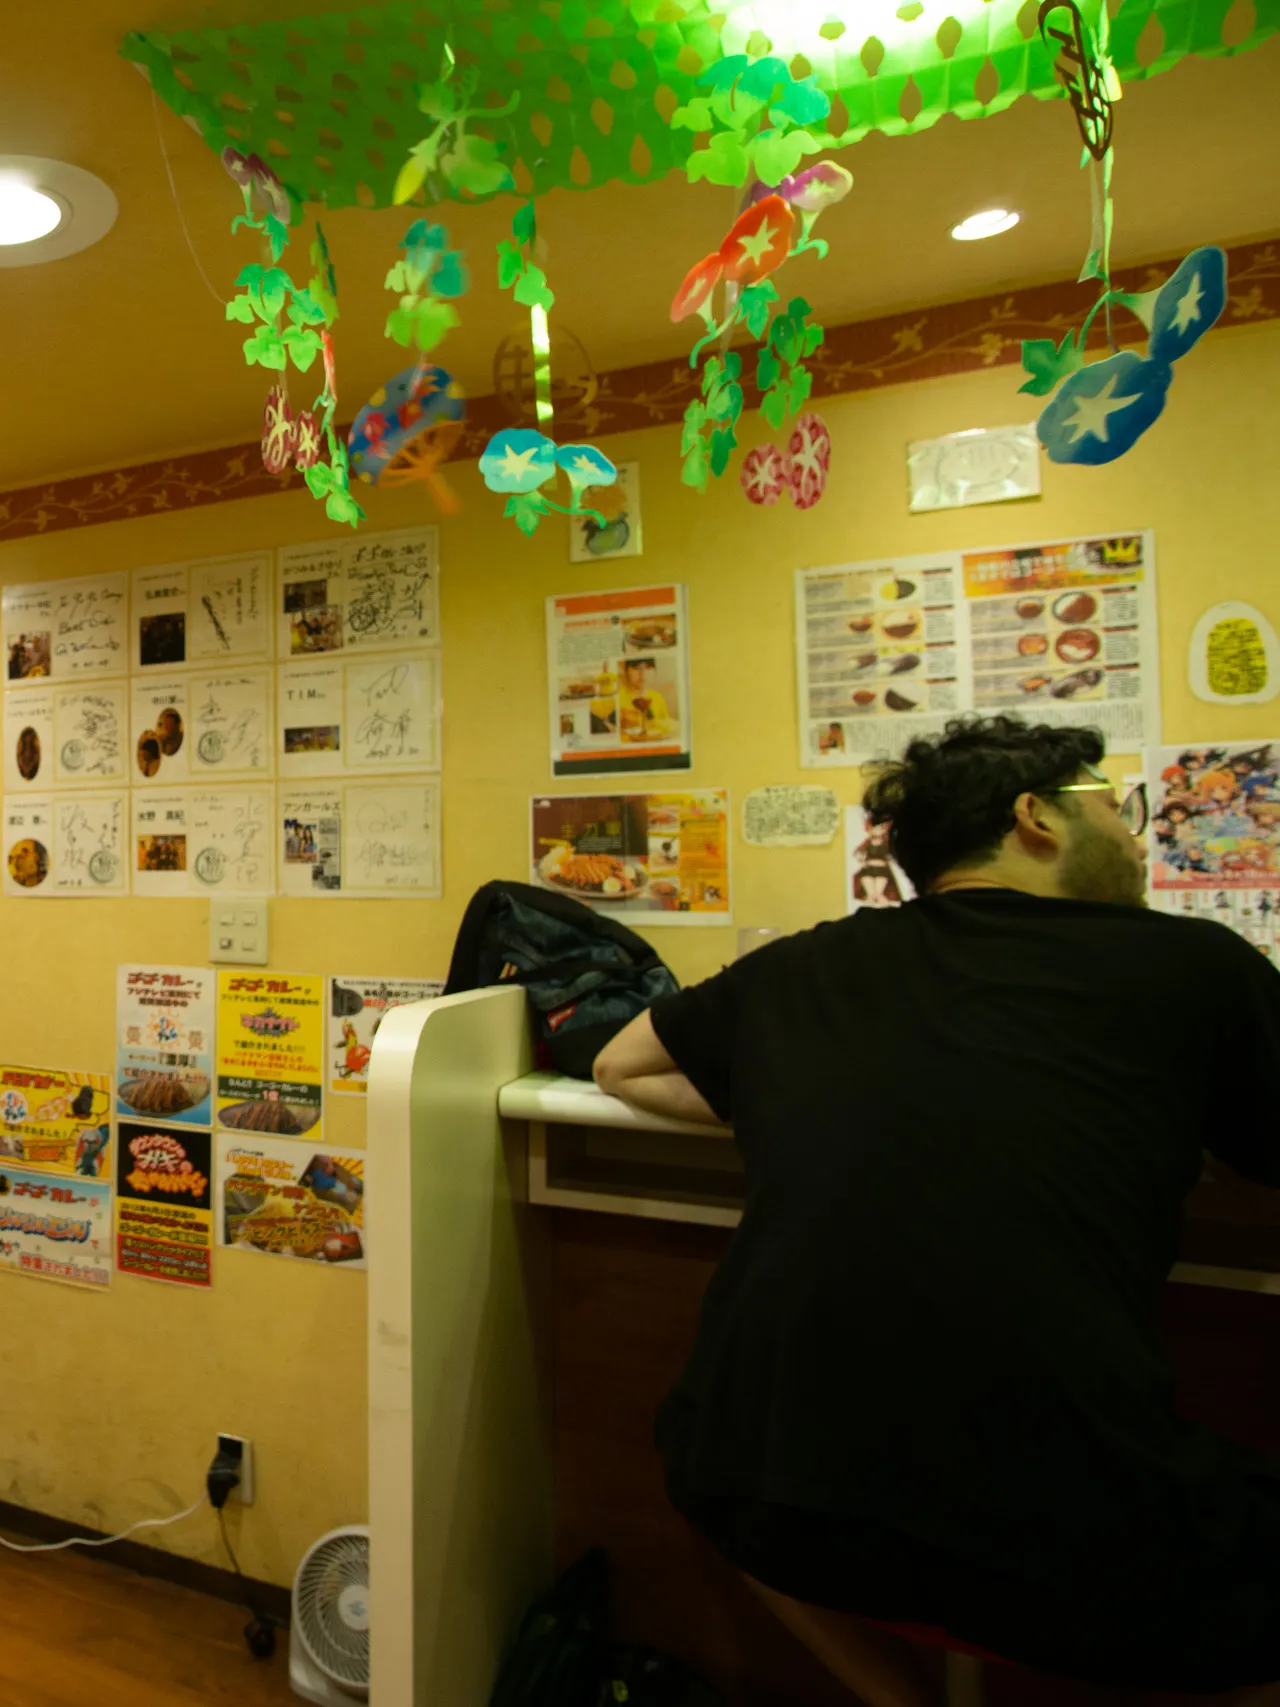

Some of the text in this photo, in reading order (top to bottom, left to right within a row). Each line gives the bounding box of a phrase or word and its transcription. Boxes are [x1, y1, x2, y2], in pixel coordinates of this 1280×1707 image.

[283, 801, 341, 813] アンガールズ
